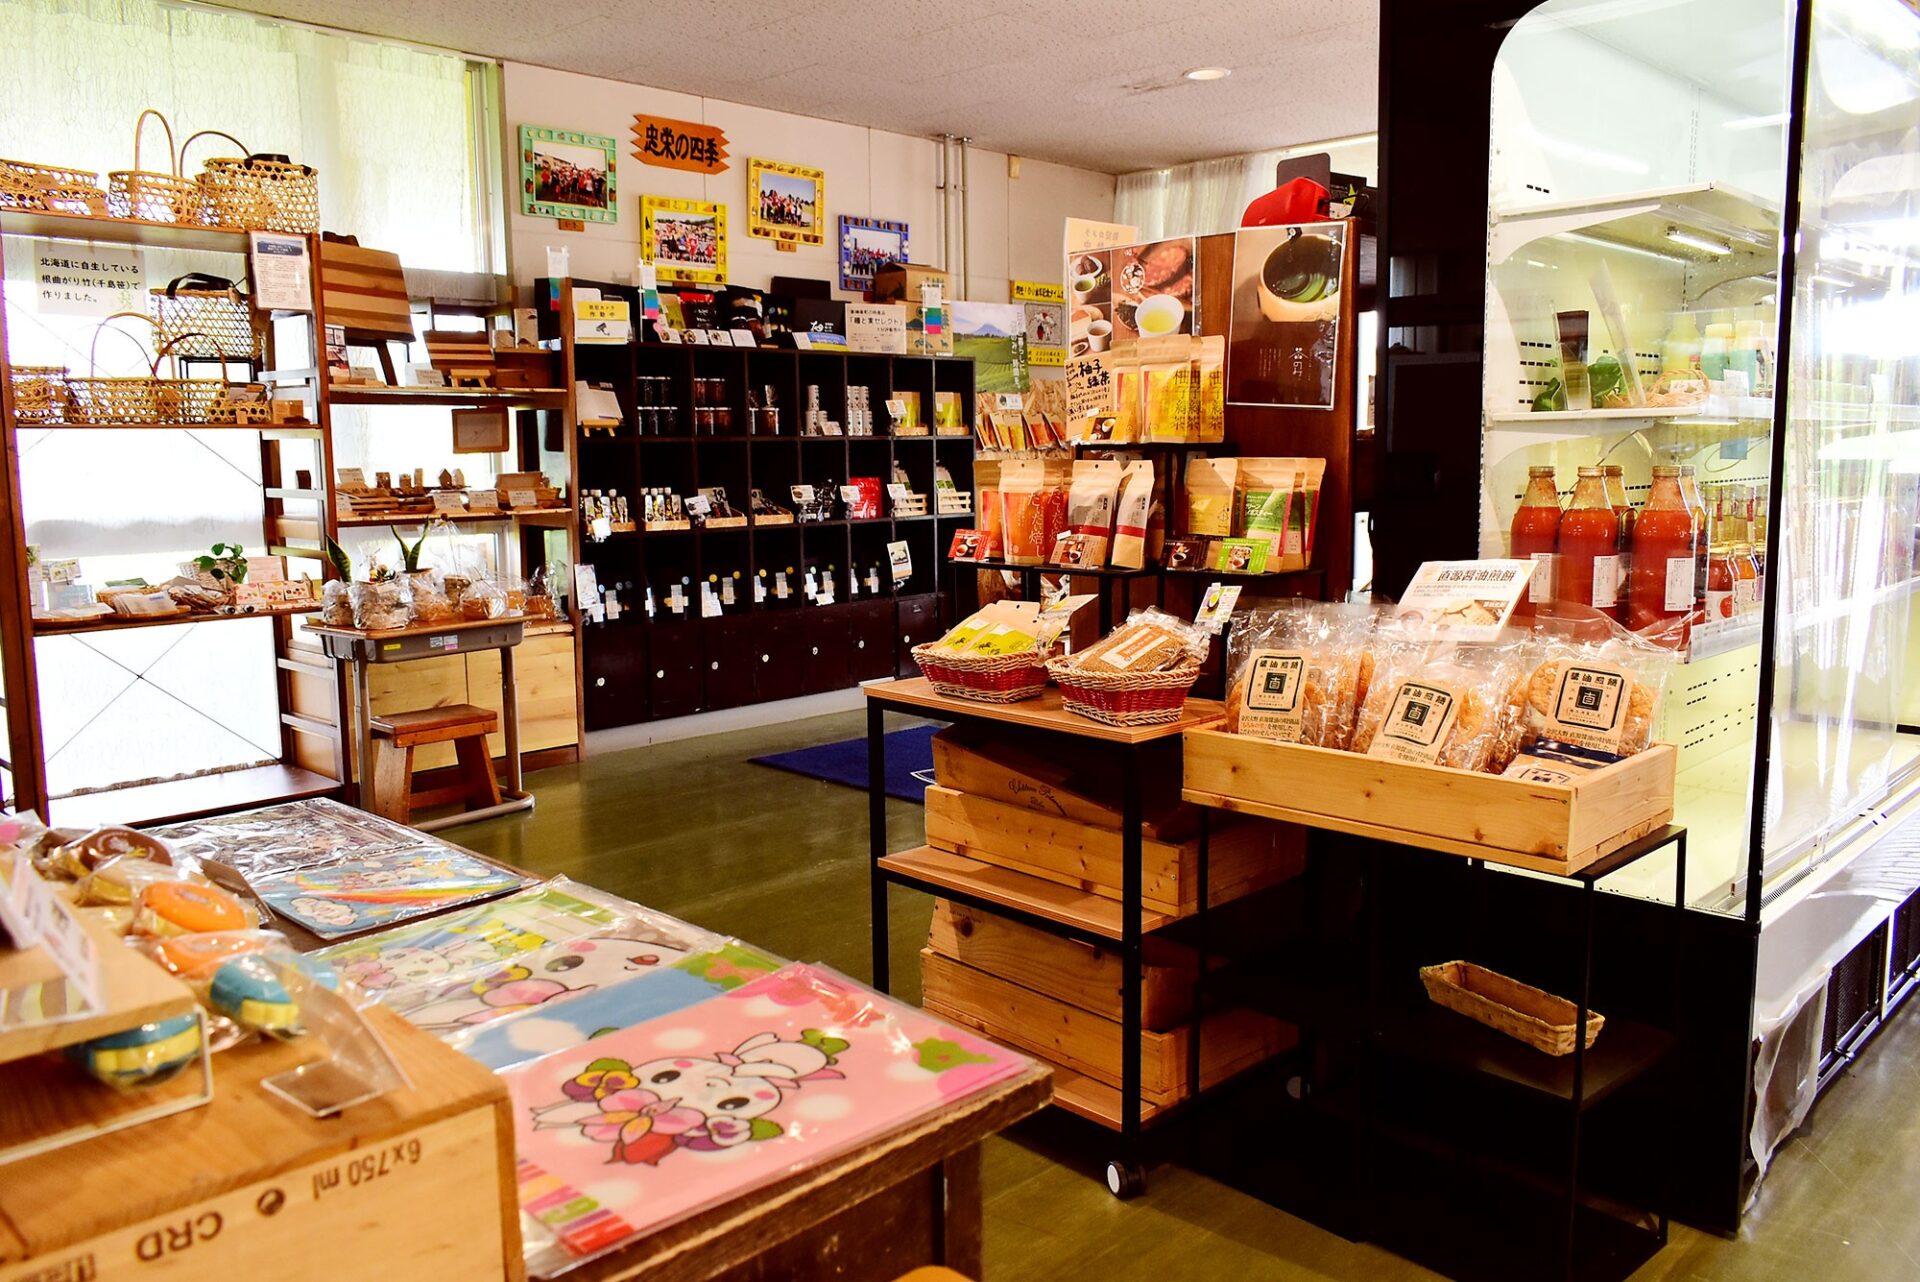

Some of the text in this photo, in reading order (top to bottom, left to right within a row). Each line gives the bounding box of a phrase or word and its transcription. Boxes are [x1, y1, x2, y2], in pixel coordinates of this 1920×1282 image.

[644, 123, 719, 167] 忠栄の四季
[40, 257, 139, 274] 北海道に自生している
[42, 290, 97, 303] 作りました。
[1437, 569, 1516, 582] 直源醤油煎餅
[1259, 660, 1299, 669] 醤油煎餅
[1570, 672, 1618, 687] 醤油煎餅
[312, 1171, 341, 1201] ml
[135, 1210, 224, 1263] CRD
